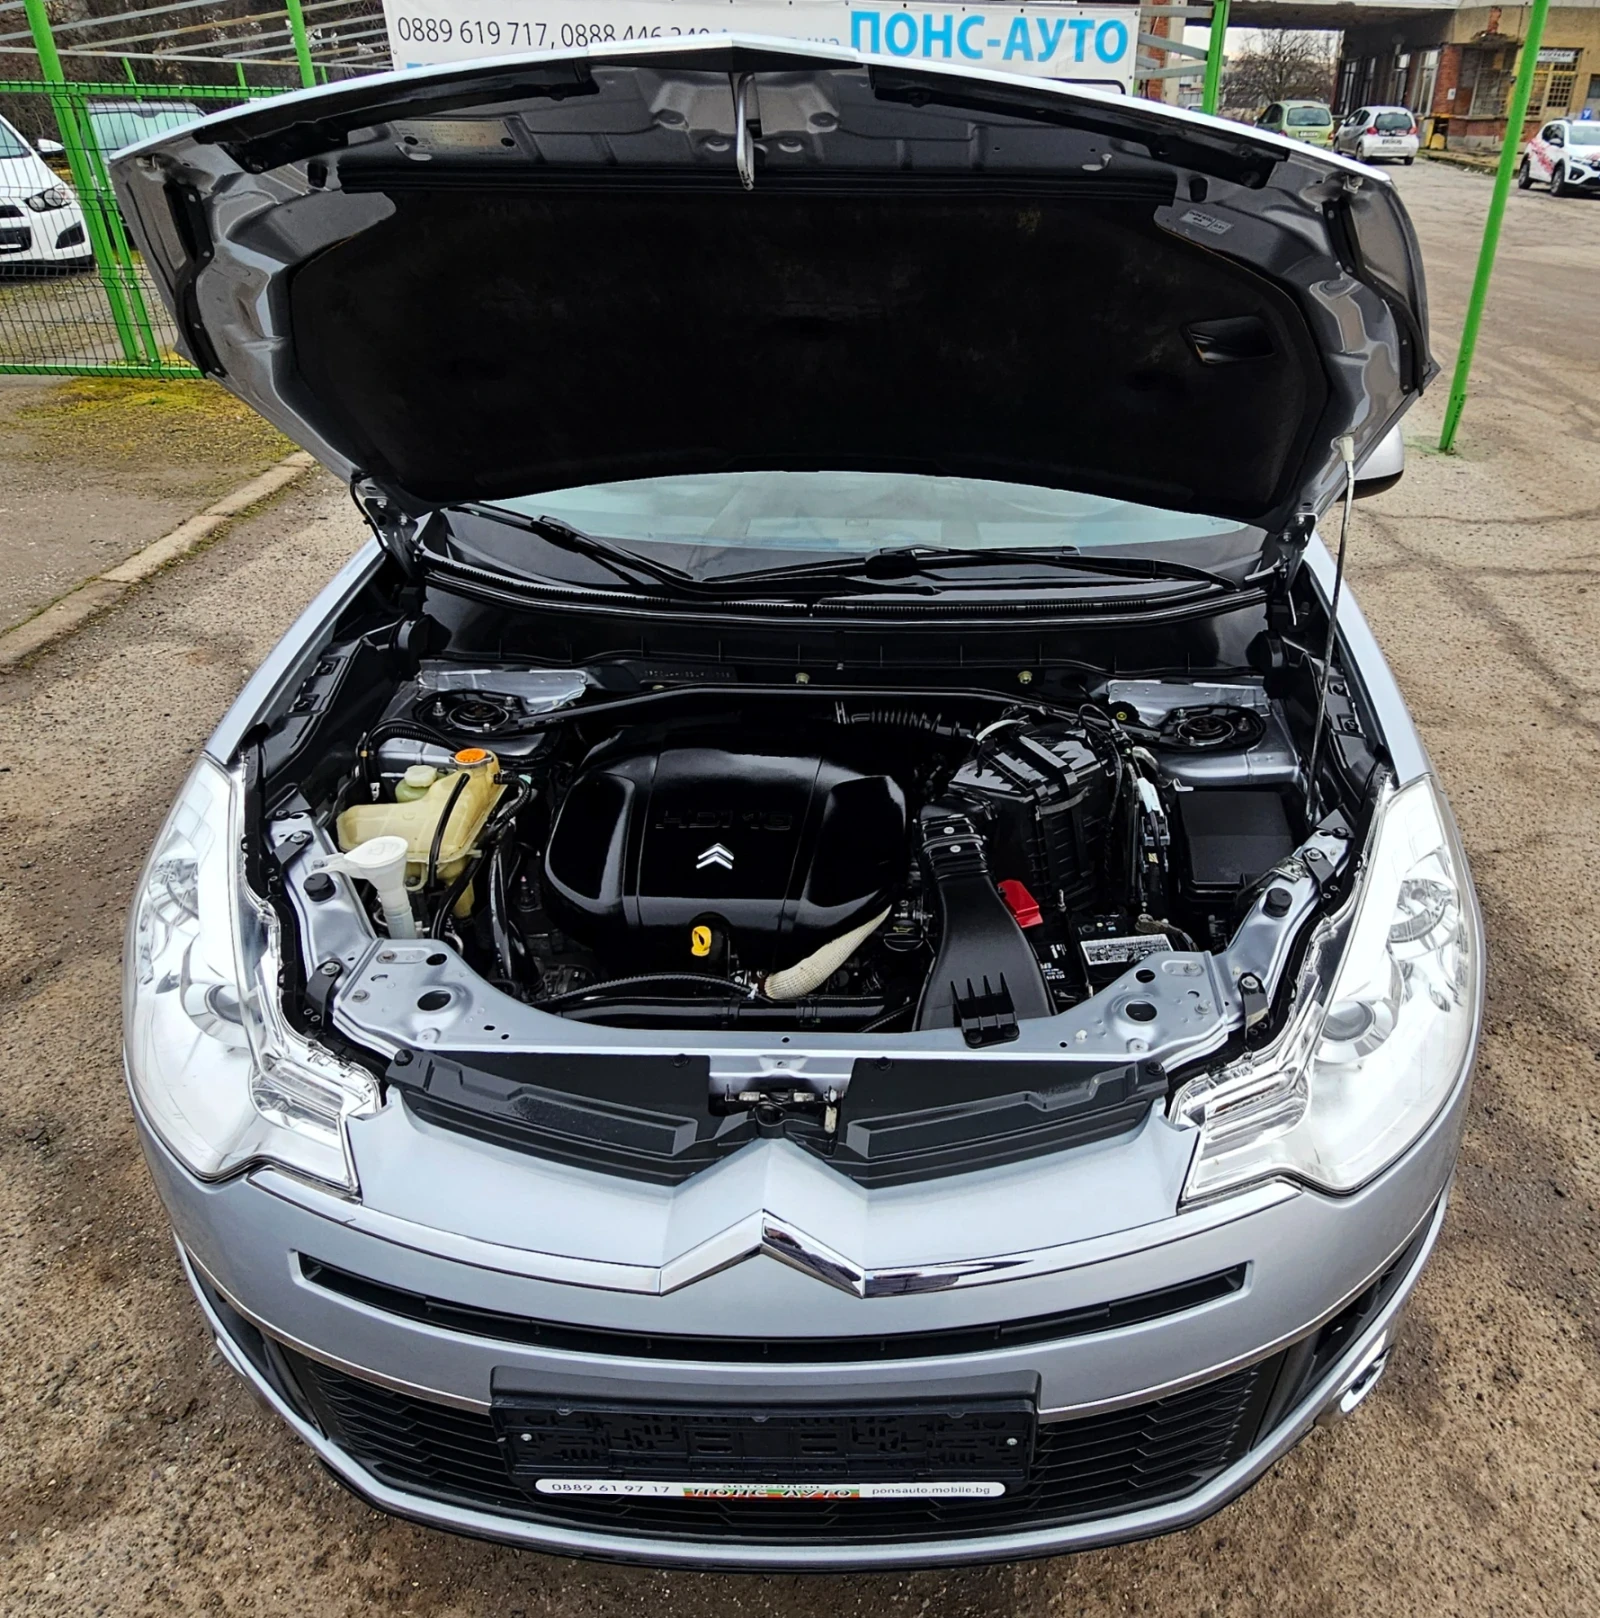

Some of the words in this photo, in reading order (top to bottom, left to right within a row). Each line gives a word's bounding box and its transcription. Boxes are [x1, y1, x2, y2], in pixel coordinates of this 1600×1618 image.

[398, 16, 453, 43] 0889
[460, 20, 501, 45] 619
[507, 21, 555, 50] 717,
[561, 23, 616, 48] 0888
[850, 10, 1129, 64] ПОНС-АУТО
[551, 1483, 593, 1492] 0889
[598, 1484, 618, 1492] 61
[624, 1485, 644, 1493] 97
[653, 1485, 670, 1493] 17
[781, 1488, 852, 1498] АУТО
[872, 1485, 991, 1495] ponsauto.mobile.bg
